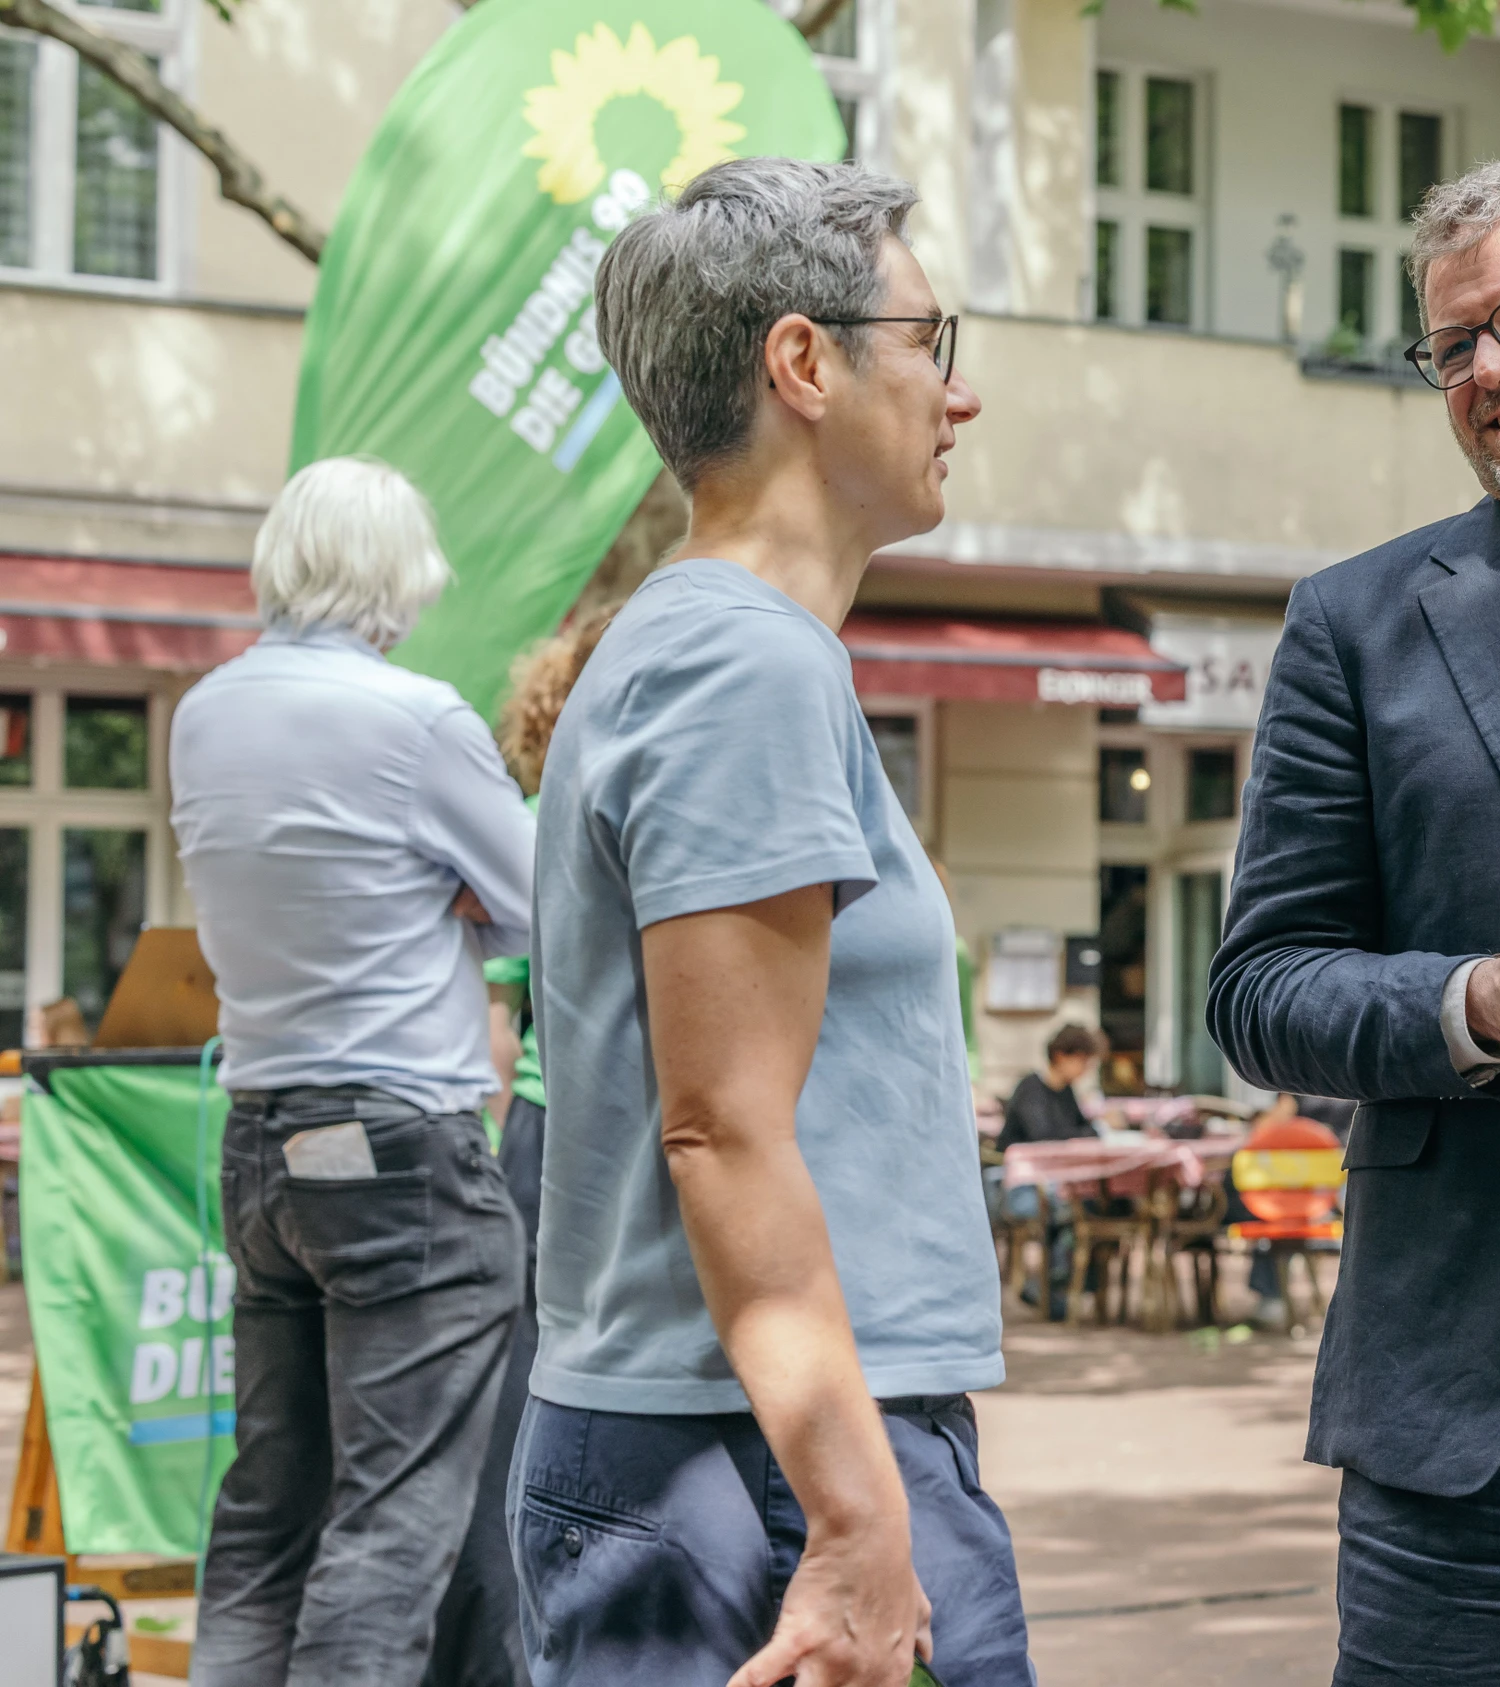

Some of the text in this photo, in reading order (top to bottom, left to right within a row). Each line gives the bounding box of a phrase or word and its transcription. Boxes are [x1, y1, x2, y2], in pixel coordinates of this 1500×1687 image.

[469, 227, 607, 417] BÜNDNIS
[510, 366, 583, 453] DIE
[1201, 656, 1271, 694] SA
[139, 1250, 237, 1330] BÜ
[129, 1334, 236, 1405] DIE
